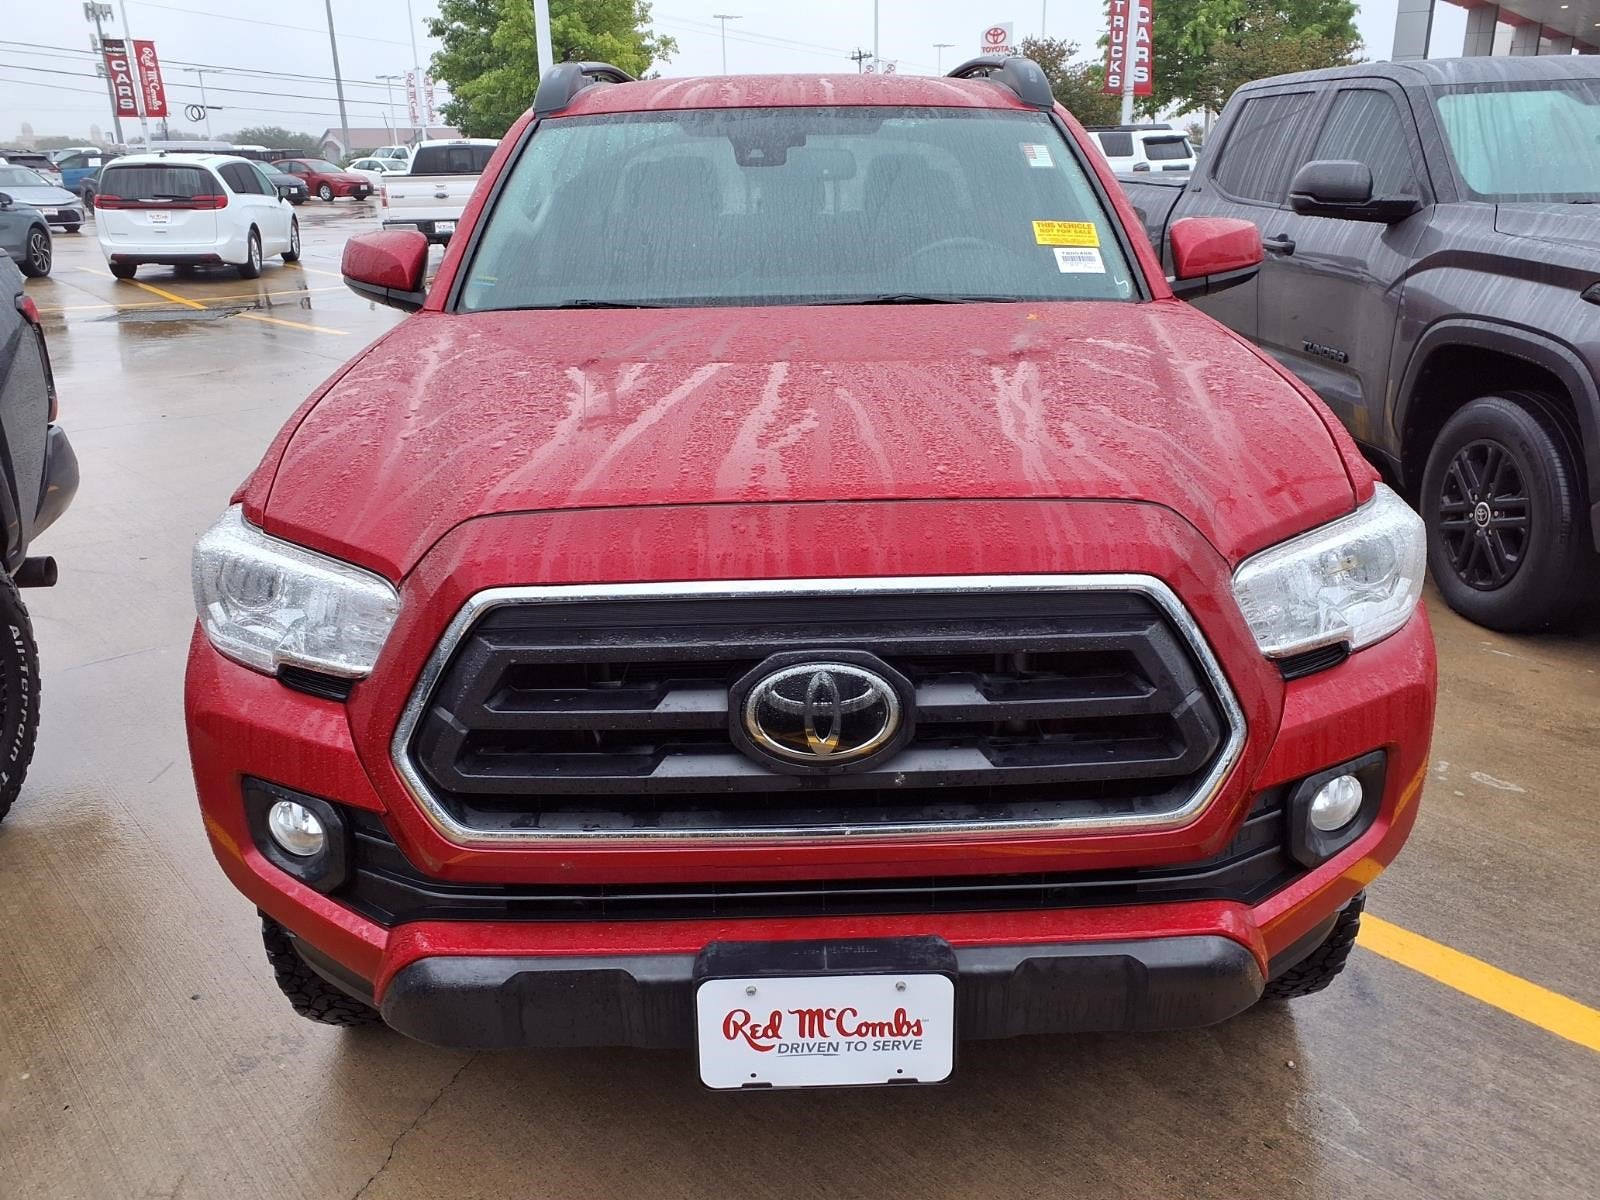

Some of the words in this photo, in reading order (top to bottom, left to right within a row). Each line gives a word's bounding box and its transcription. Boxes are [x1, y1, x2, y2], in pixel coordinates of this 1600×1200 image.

[981, 45, 1010, 53] TOYOTA
[1108, 1, 1124, 87] TRUCKS
[1134, 6, 1149, 82] CARS
[111, 60, 134, 109] CARS
[1302, 340, 1349, 364] TUNDRA
[722, 1008, 783, 1051] Red
[787, 1007, 923, 1038] McCombs
[777, 1041, 840, 1054] DRIVEN
[845, 1040, 868, 1052] TO
[872, 1039, 923, 1051] SERVE
